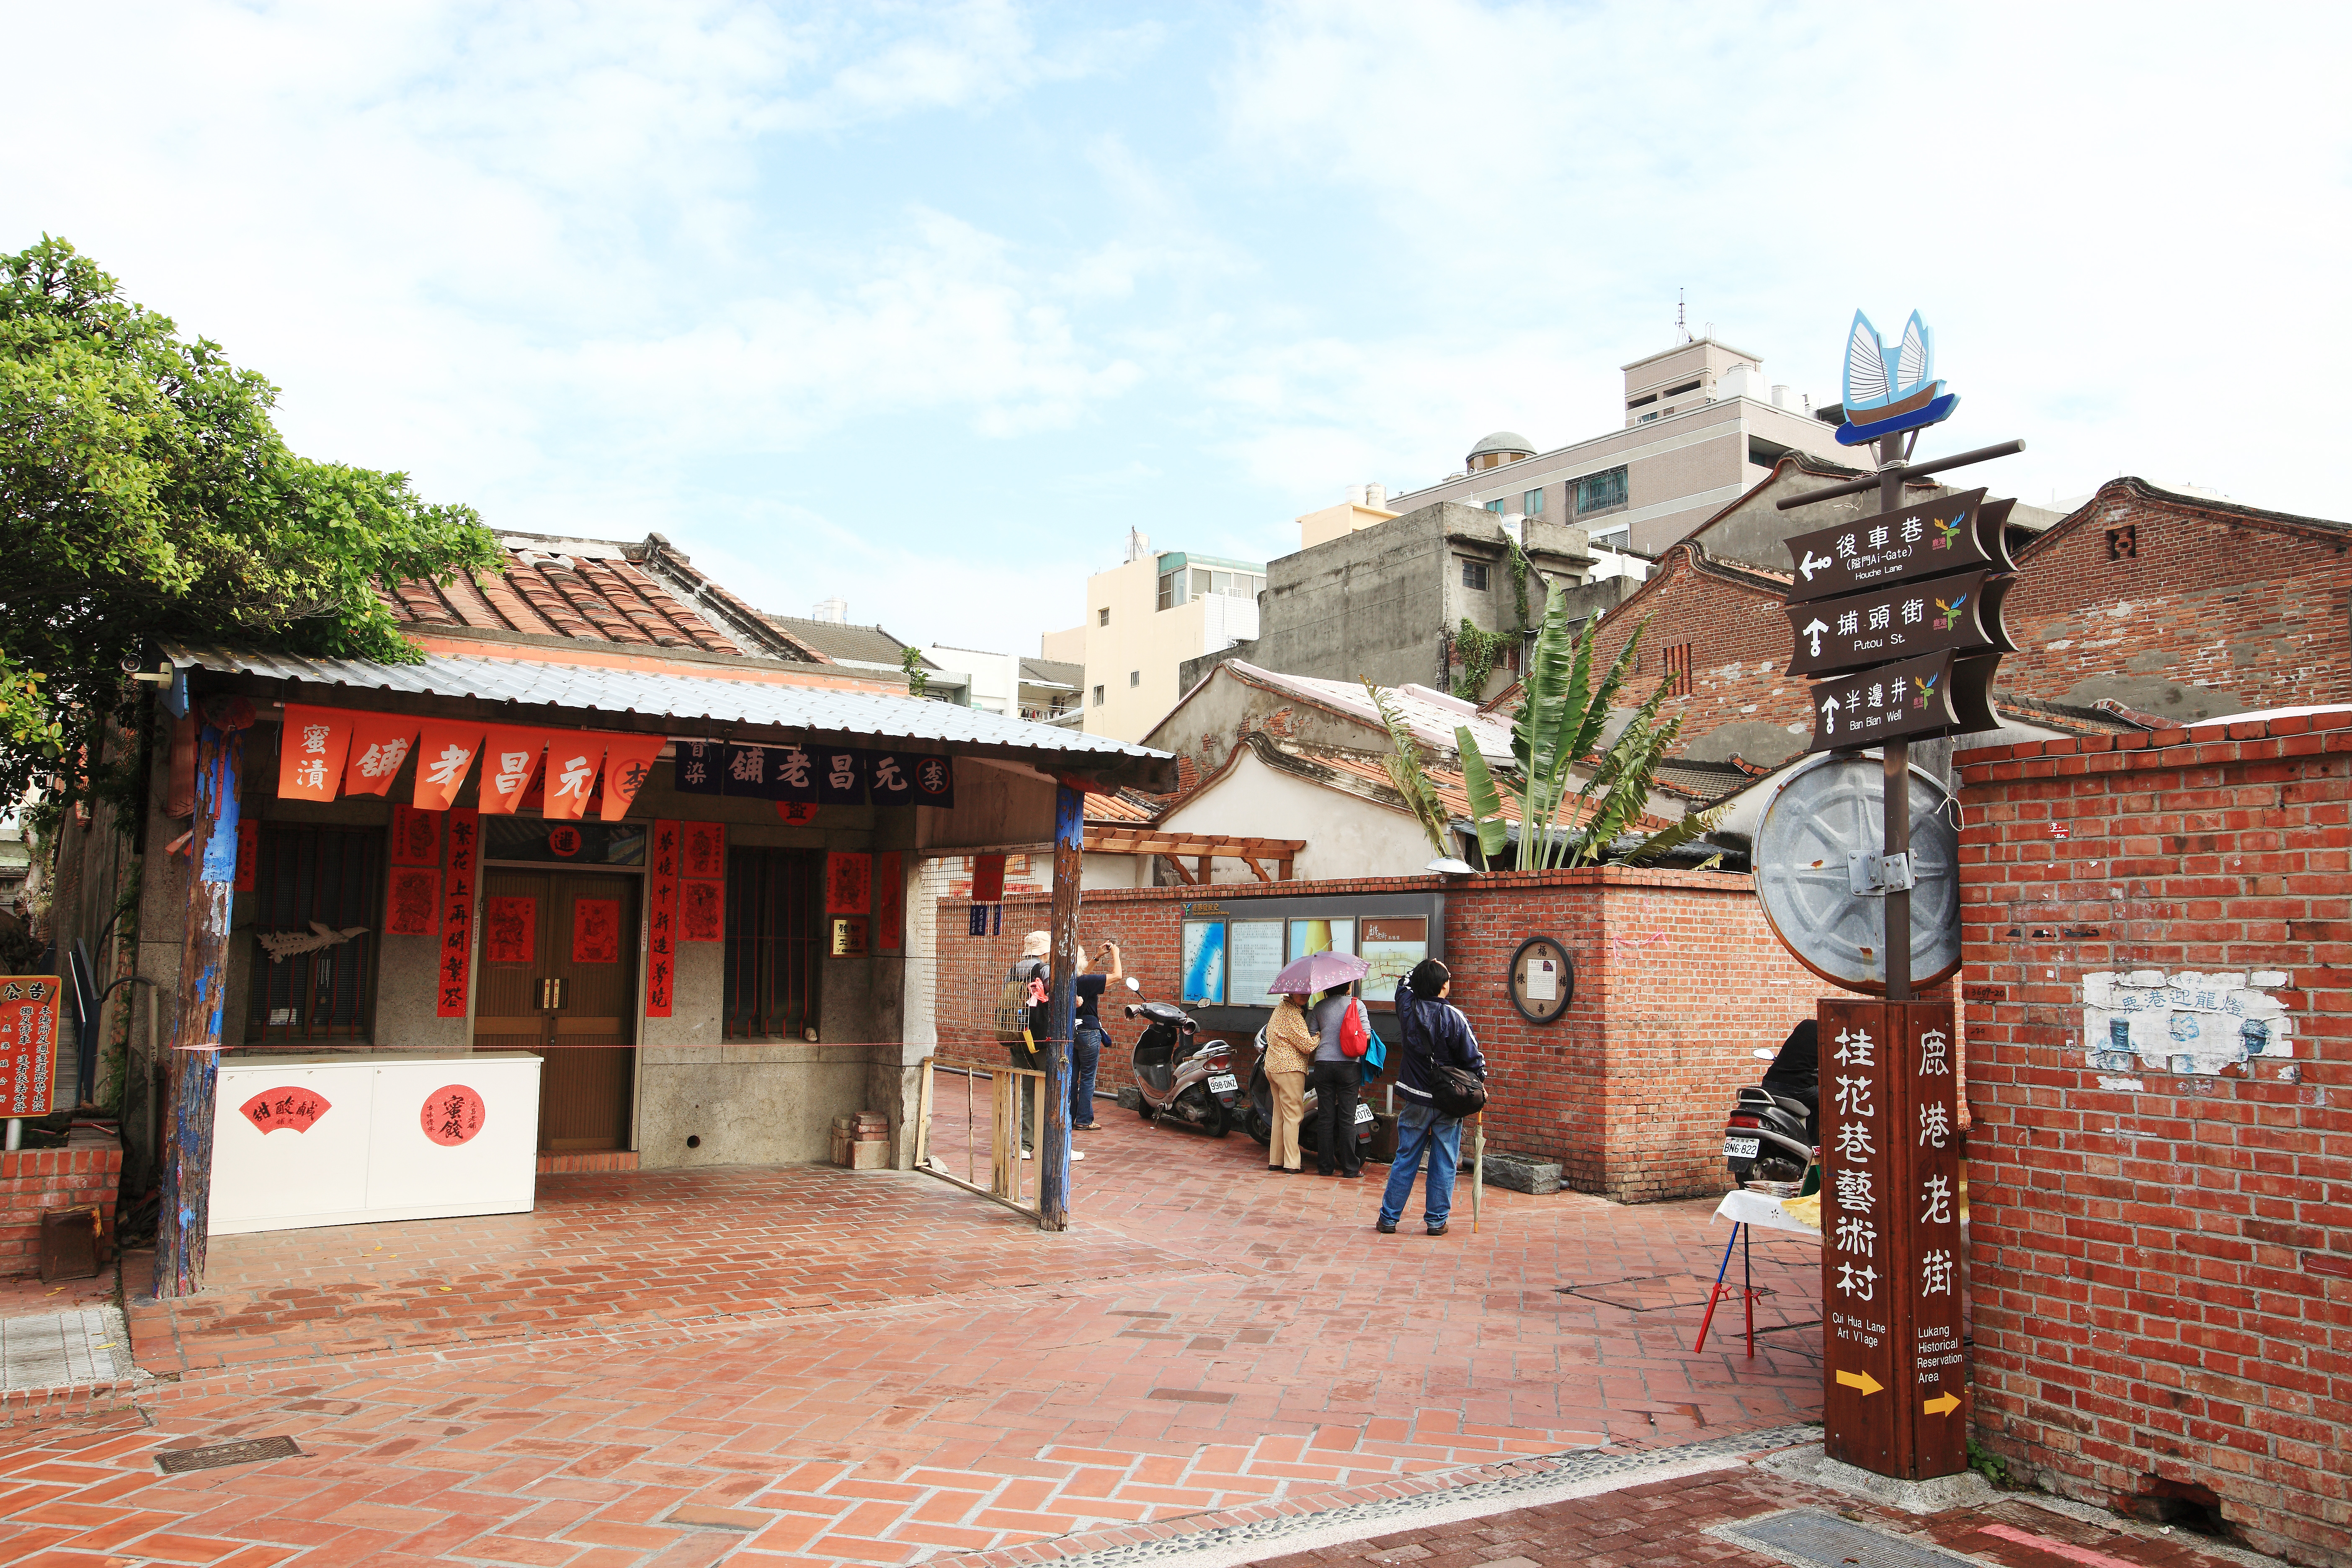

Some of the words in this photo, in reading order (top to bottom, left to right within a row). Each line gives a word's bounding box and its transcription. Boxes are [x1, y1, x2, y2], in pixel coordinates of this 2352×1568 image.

[1836, 516, 1923, 559] 後車巷
[1855, 568, 1881, 580] Houche
[1884, 564, 1903, 574] Lane
[1837, 599, 1924, 636] 埔頭街
[1854, 639, 1883, 651] Putou
[1890, 633, 1905, 645] St.
[1845, 676, 1907, 713] 半邊井
[1850, 720, 1863, 731] Ban
[1866, 716, 1881, 727] Bian
[1886, 709, 1902, 722] Well
[297, 724, 331, 791] 蜜漬
[1537, 944, 1547, 957] 福
[3, 981, 46, 1000] 公告
[2122, 989, 2245, 1018] 鹿港迎龍燈
[1834, 1027, 1877, 1301] 桂花巷藝術村
[1919, 1028, 1953, 1297] 鹿港老街
[1837, 1327, 1849, 1339] Art
[1847, 1314, 1862, 1328] Hua
[1867, 1319, 1885, 1334] Lane
[1918, 1326, 1950, 1338] Lukang
[1919, 1337, 1958, 1354] Historical
[1917, 1353, 1963, 1369] Reservation
[1918, 1372, 1939, 1384] Area
